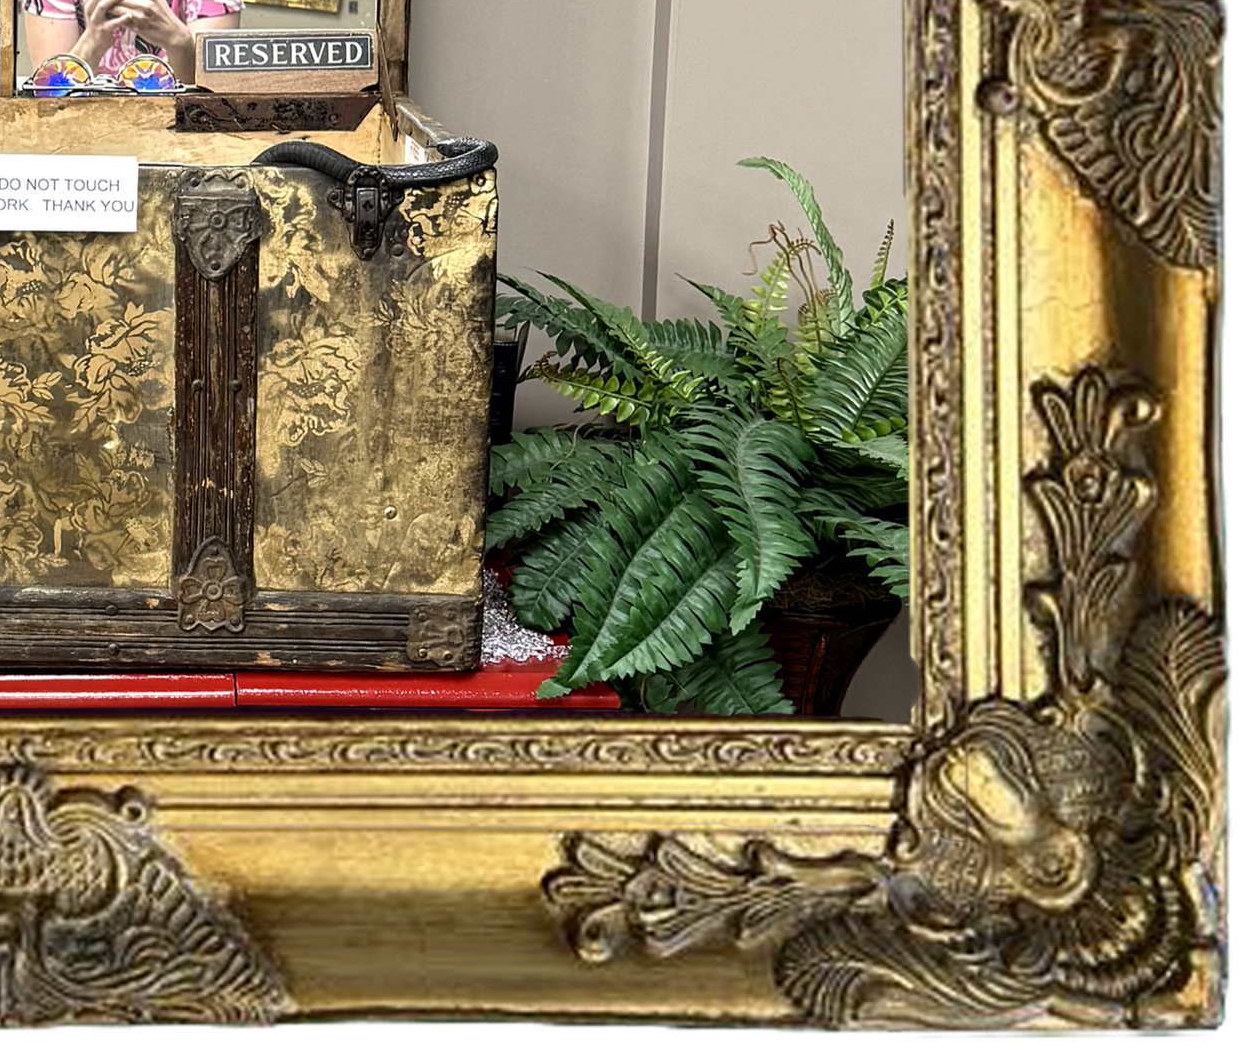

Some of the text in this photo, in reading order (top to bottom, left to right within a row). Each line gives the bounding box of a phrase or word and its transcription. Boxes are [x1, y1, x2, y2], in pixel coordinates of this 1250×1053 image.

[215, 41, 363, 66] RESERVED
[26, 178, 59, 191] NOT
[64, 178, 120, 192] TOUCH
[42, 198, 95, 212] THANK
[100, 199, 135, 213] YOU
